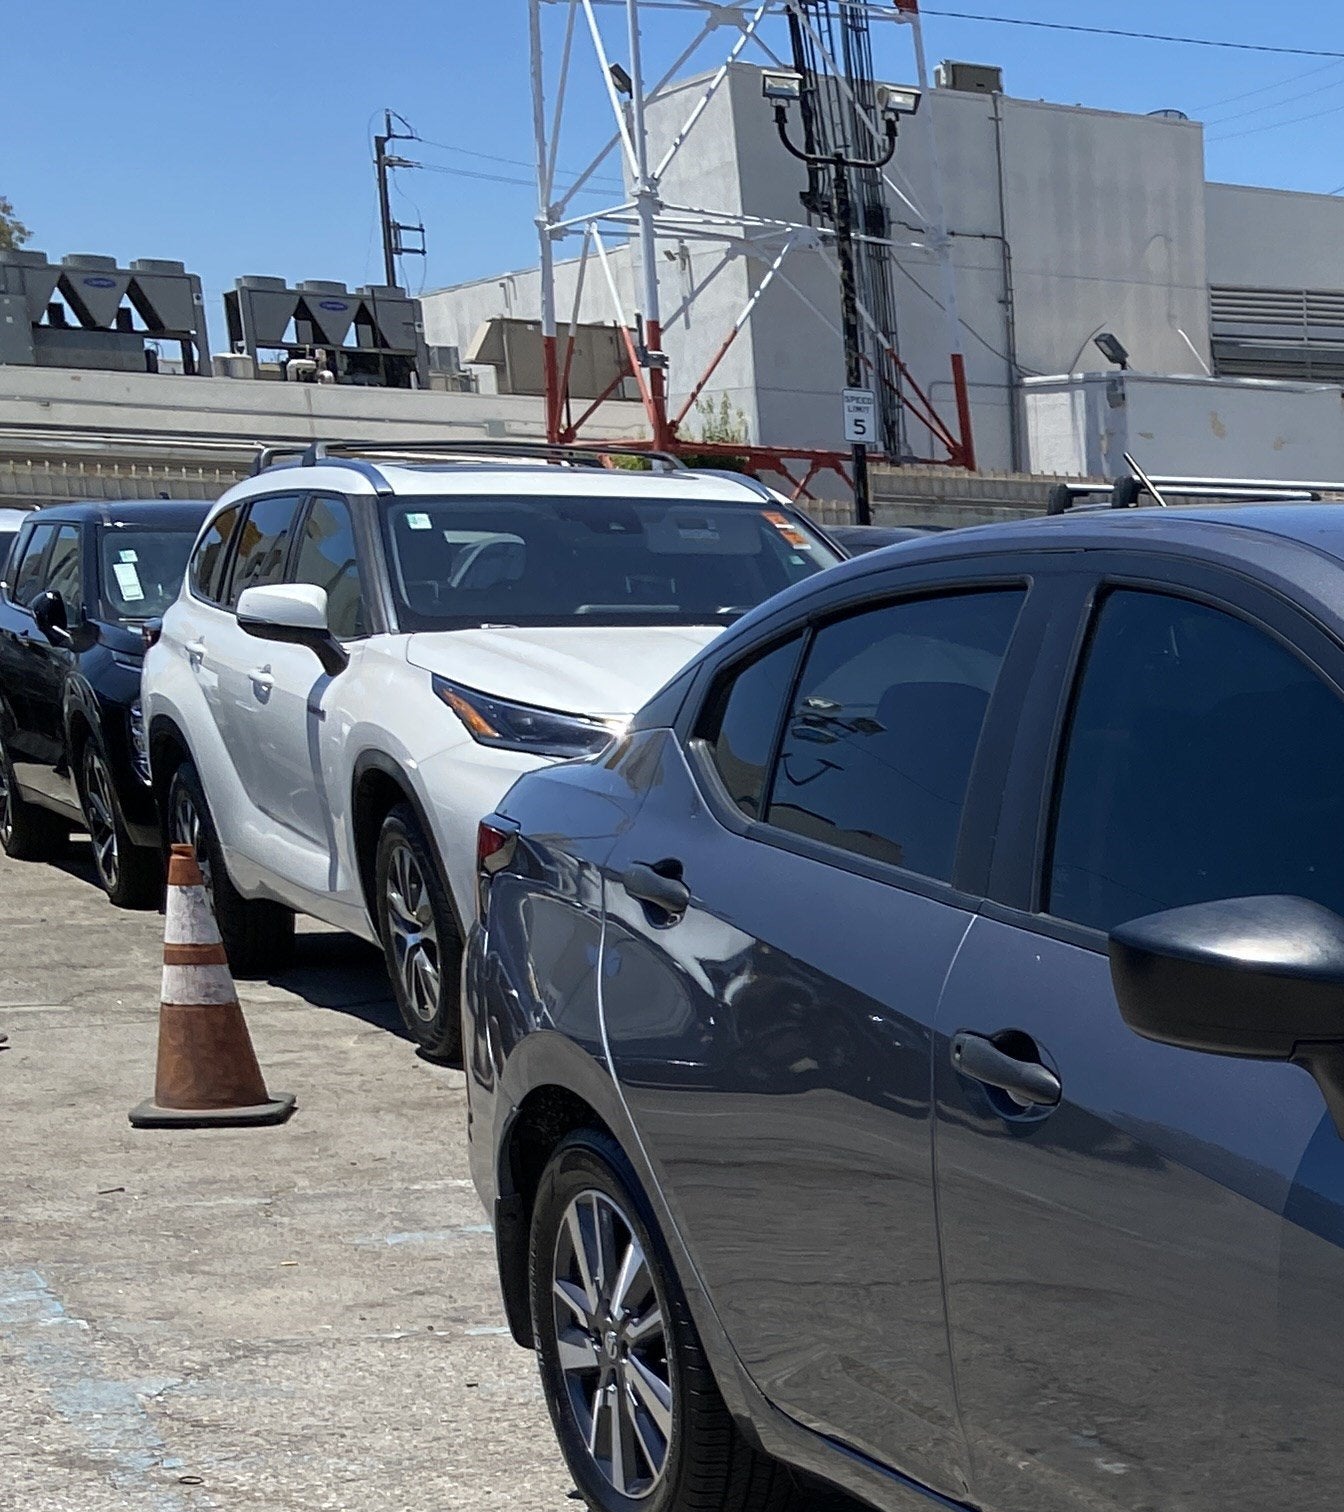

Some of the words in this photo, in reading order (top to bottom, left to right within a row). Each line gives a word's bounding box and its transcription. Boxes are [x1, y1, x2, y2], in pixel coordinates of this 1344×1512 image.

[844, 396, 873, 404] SPEED
[847, 405, 870, 413] LIMIT
[853, 418, 866, 435] 5
